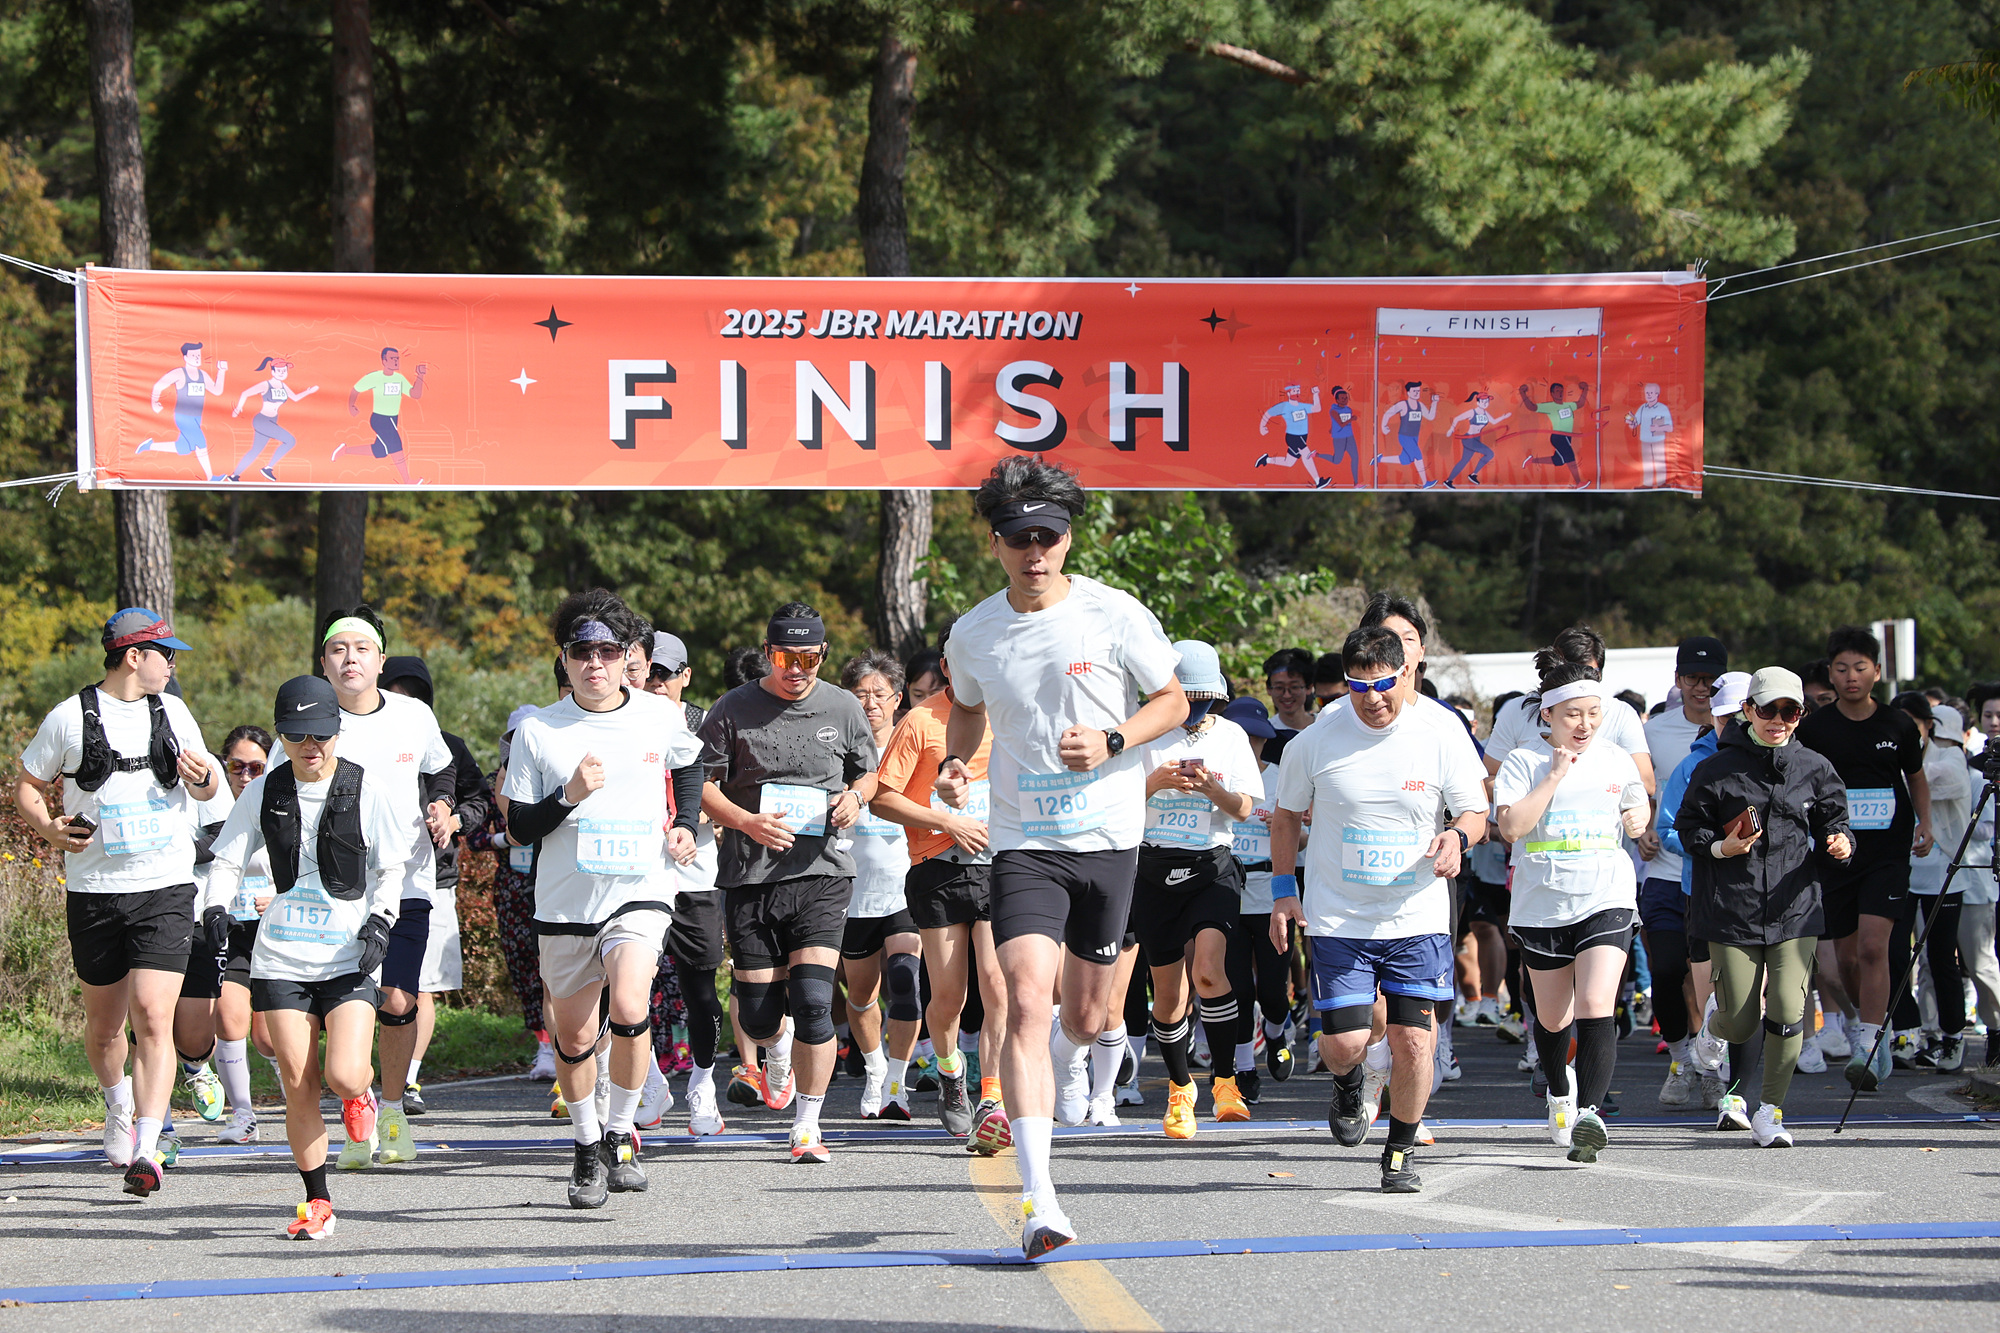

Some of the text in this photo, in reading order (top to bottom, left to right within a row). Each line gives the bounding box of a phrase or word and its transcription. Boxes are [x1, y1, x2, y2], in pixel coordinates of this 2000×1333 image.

[720, 308, 1083, 341] 2025 JBR MARATHON
[1448, 317, 1529, 330] FINISH
[191, 385, 203, 393] 124
[387, 385, 399, 393] 123
[608, 359, 1189, 452] FINISH
[787, 628, 810, 636] cep
[1065, 661, 1092, 675] JBR
[395, 753, 414, 763] JBR
[642, 752, 660, 764] JBR
[1073, 771, 1096, 783] 마라톤
[1211, 771, 1224, 782] BR
[1401, 780, 1425, 791] JBR
[774, 801, 816, 819] 1263
[1033, 791, 1088, 816] 1260
[1852, 802, 1888, 817] 1273
[1040, 822, 1077, 831] MARATHON
[1158, 812, 1198, 829] 1203
[115, 817, 161, 838] 1156
[593, 838, 638, 857] 1151
[1233, 837, 1259, 853] 201
[1356, 849, 1405, 868] 1250
[1169, 867, 1191, 879] NIKE
[233, 892, 257, 907] 152
[283, 904, 332, 926] 1157
[283, 930, 317, 939] MARATHON
[800, 1095, 823, 1103] cep
